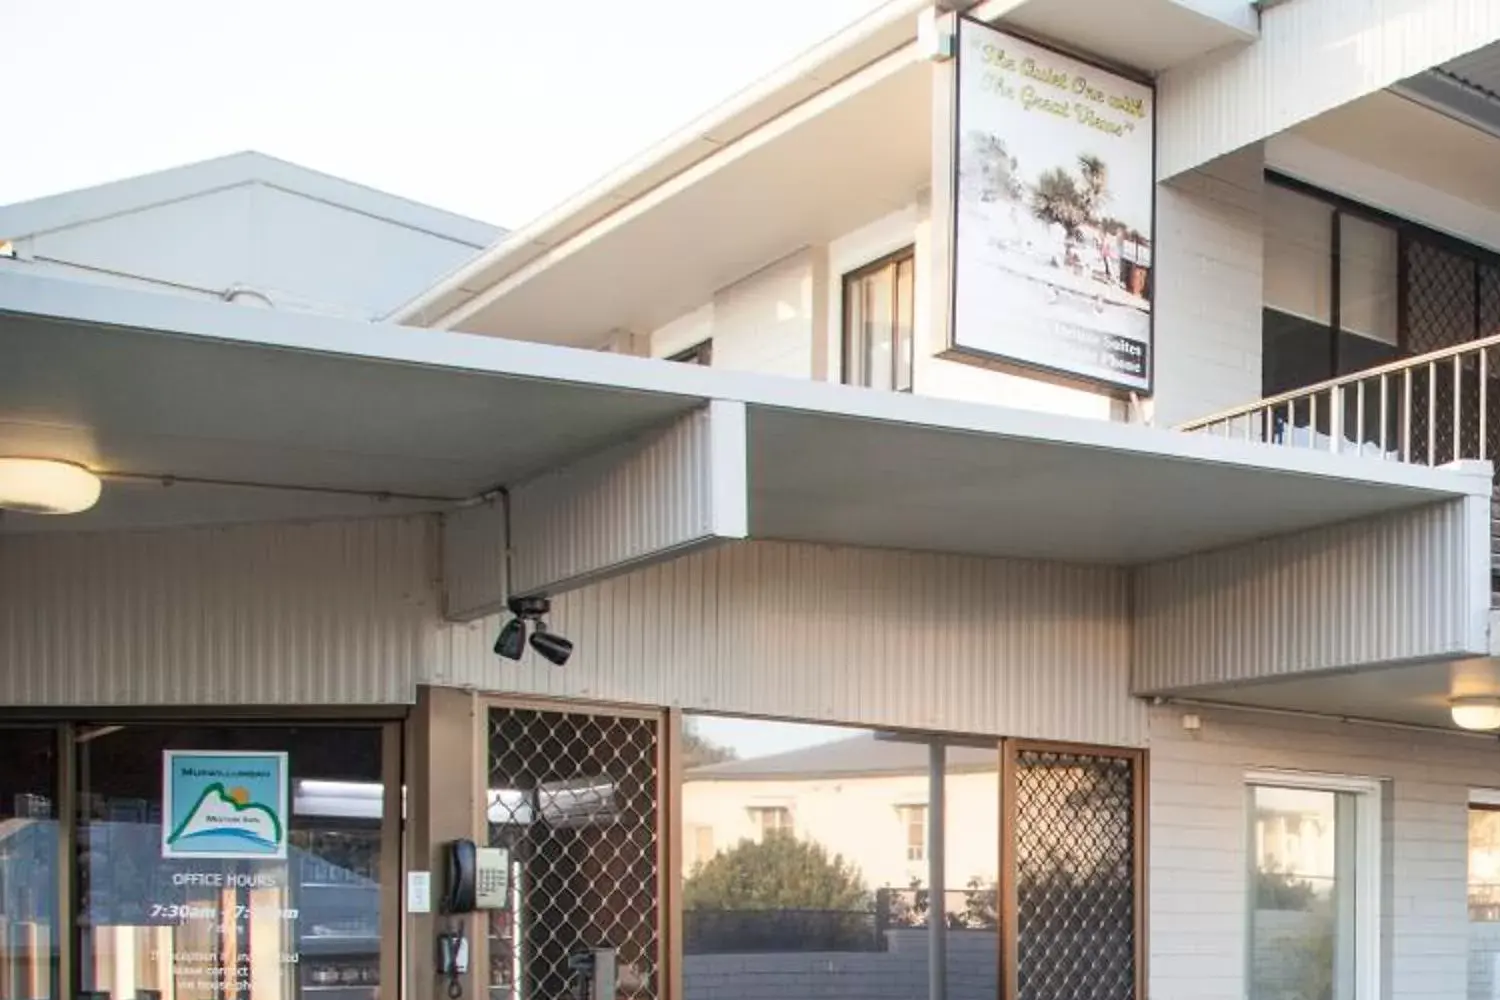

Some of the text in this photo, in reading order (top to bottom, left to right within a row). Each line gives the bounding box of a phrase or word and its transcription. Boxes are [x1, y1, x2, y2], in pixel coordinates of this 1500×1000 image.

[1071, 75, 1105, 103] One
[1020, 85, 1071, 118] Great
[172, 872, 277, 888] OFFICE HOURS
[150, 903, 217, 919] 7:30am
